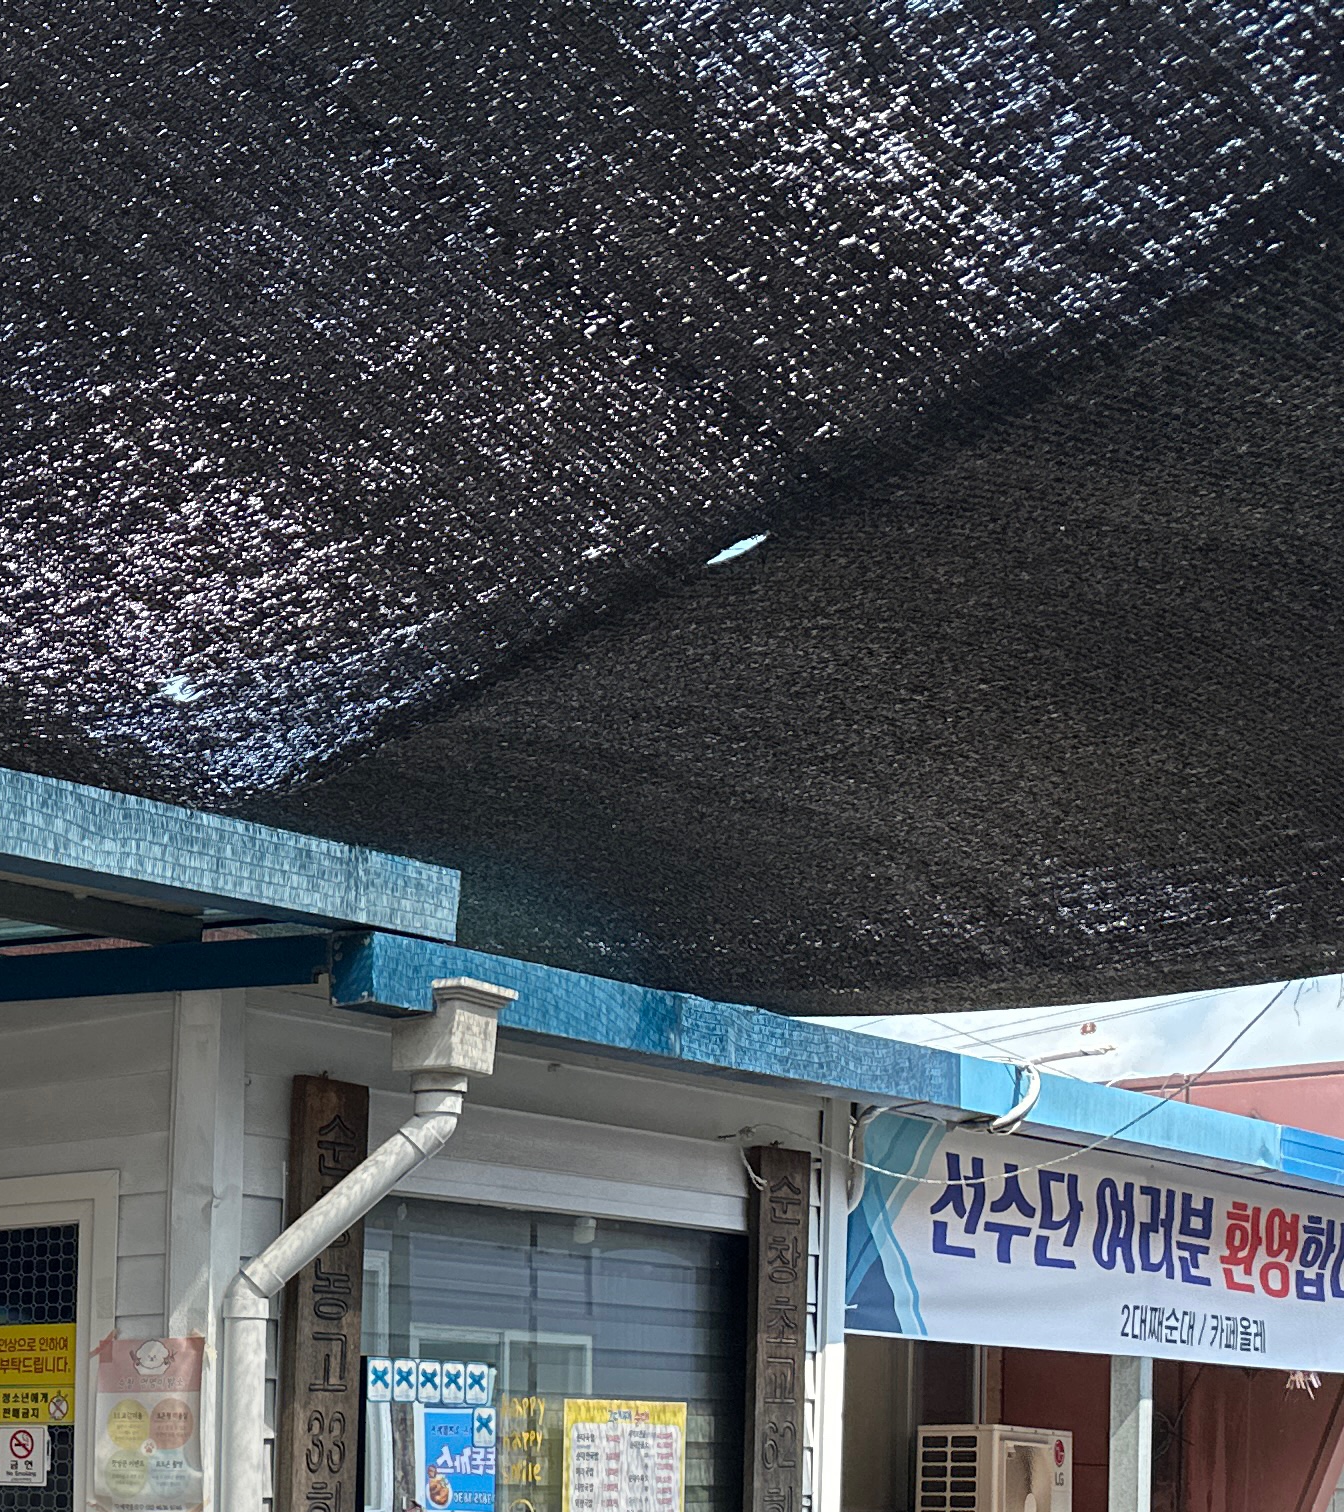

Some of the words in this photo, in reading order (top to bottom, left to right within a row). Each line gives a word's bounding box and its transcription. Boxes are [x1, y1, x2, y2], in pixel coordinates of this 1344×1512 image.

[929, 1150, 1085, 1271] 선수단
[1091, 1176, 1216, 1287] 여러분
[766, 1175, 802, 1406] 순창초교
[1120, 1304, 1195, 1348] 2대째순대
[1209, 1312, 1268, 1355] 카페올레
[39, 1336, 69, 1352] 인하여
[2, 1392, 49, 1404] 청소년에게
[2, 1407, 40, 1419] 판매금지
[1054, 1471, 1065, 1486] LG
